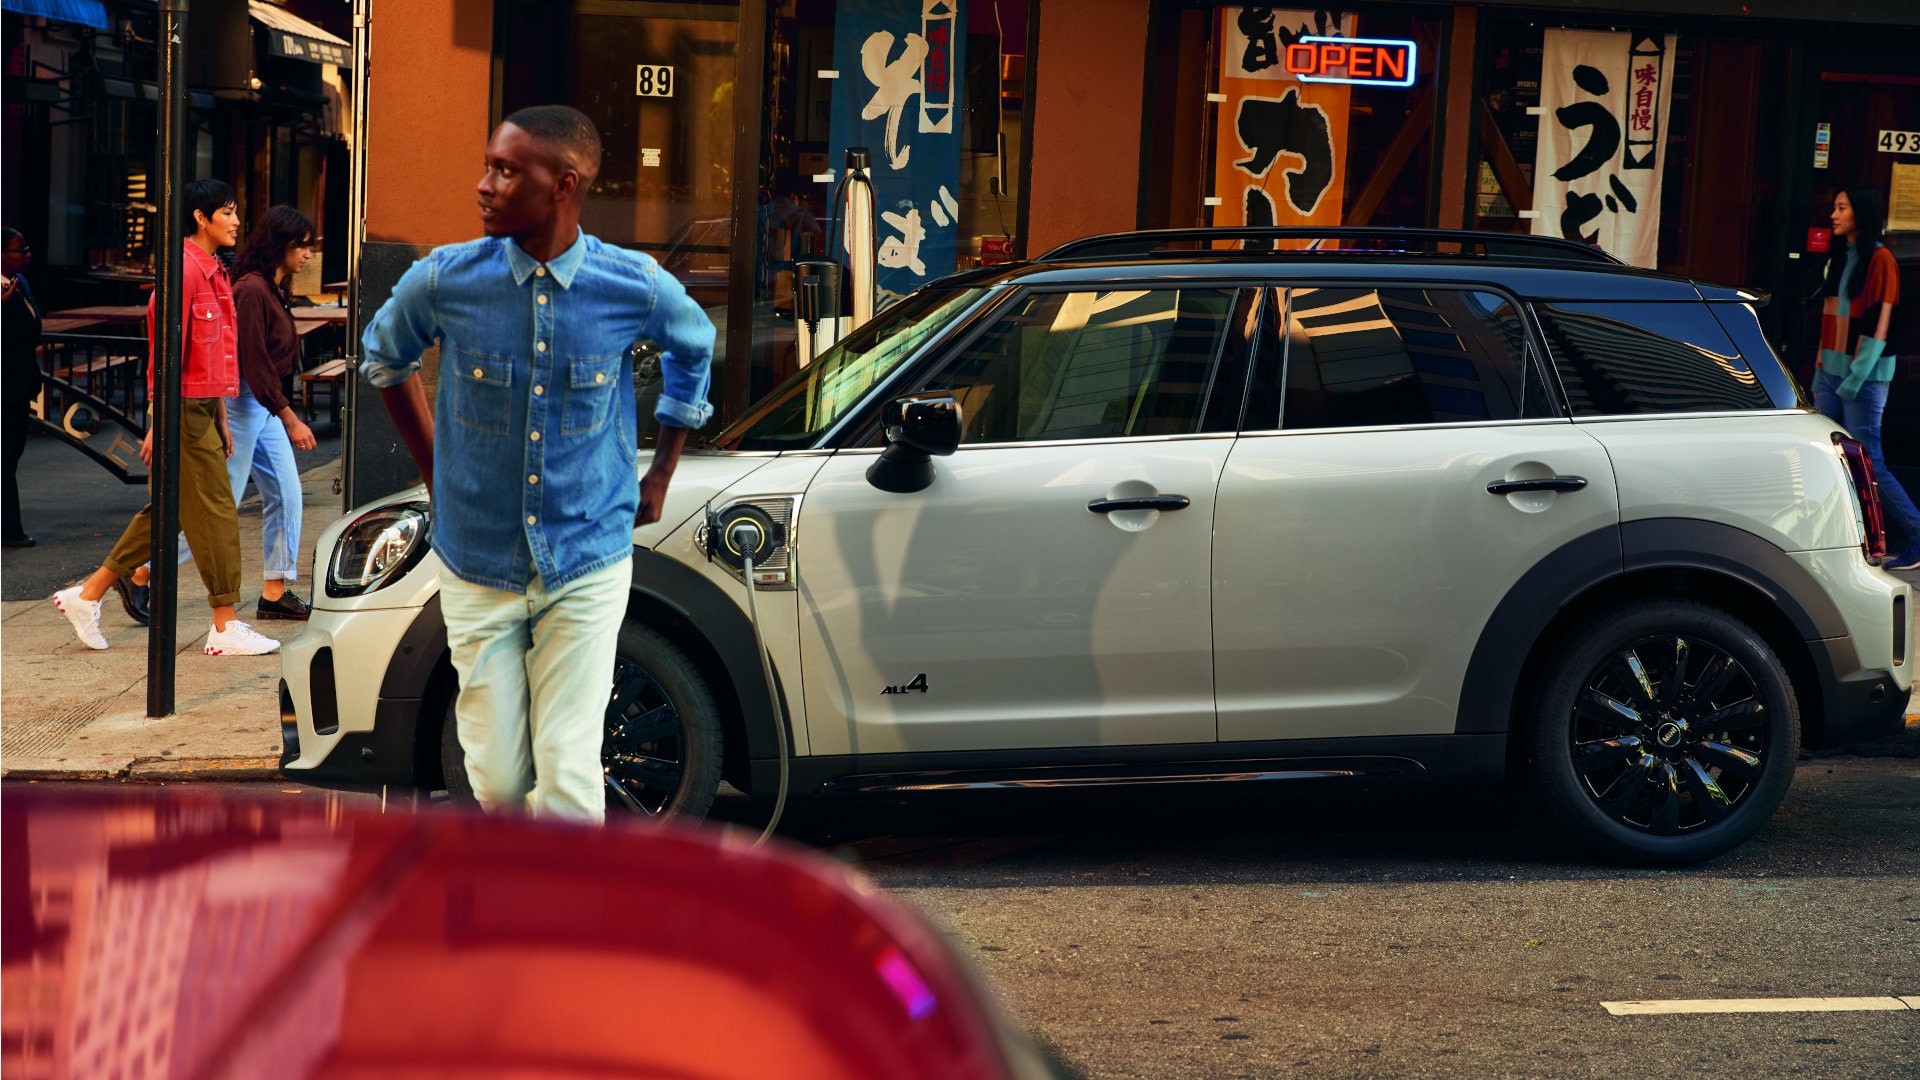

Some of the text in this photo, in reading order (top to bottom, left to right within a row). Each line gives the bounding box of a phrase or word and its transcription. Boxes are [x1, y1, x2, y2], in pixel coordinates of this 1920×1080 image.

[1285, 43, 1406, 79] OPEN
[640, 67, 671, 95] 89
[1631, 63, 1657, 131] 味自慢
[1880, 132, 1920, 152] 493
[1661, 726, 1677, 743] MINI
